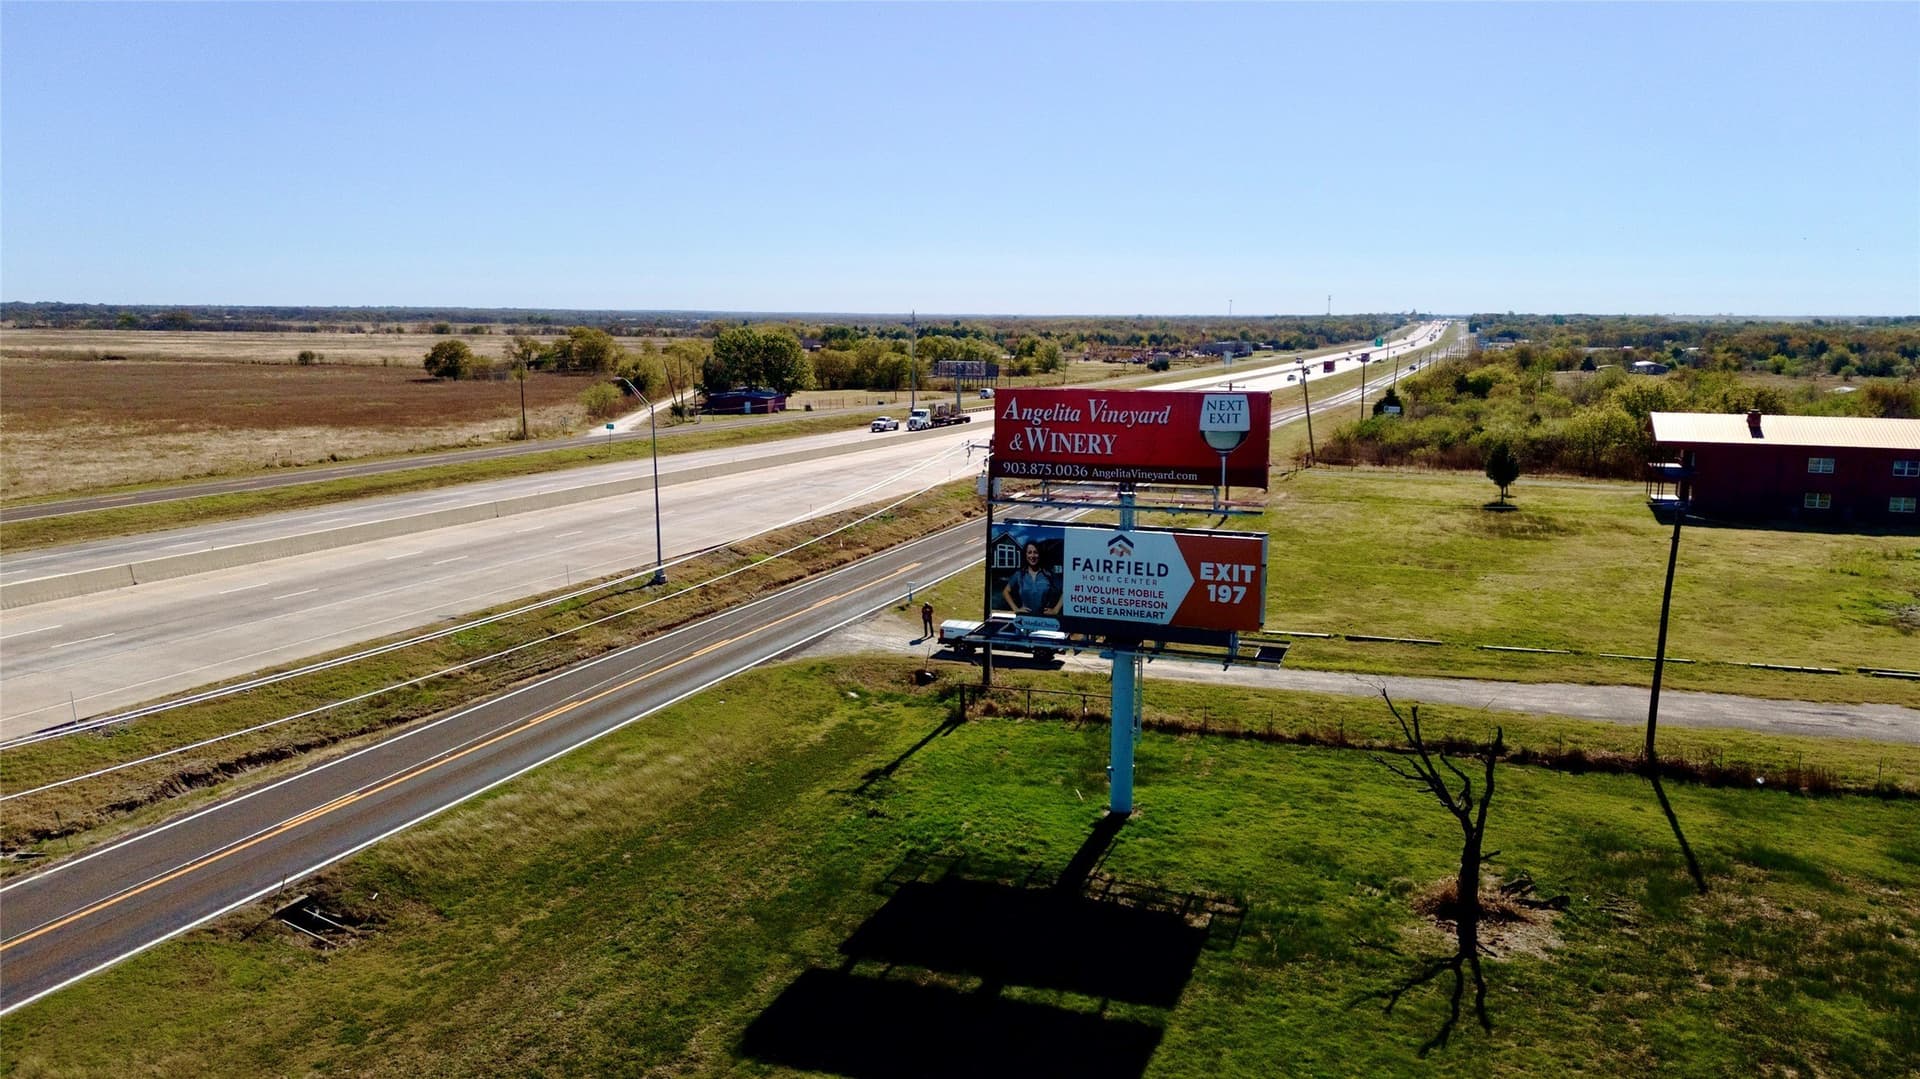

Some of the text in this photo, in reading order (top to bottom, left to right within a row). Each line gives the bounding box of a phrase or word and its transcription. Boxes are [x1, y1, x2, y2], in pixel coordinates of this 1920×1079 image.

[1001, 396, 1171, 428] Angelita Vineyard
[1206, 400, 1245, 411] NEXT
[1209, 413, 1240, 424] EXIT
[1003, 462, 1198, 481] 903.875.0036 AngelitaVineyard.com
[1072, 557, 1169, 577] FAIRFIELD
[1200, 562, 1256, 583] EXIT
[1082, 574, 1158, 586] HOME CENTER
[1087, 585, 1125, 596] VOLUME
[1128, 588, 1165, 599] MOBILE
[1207, 584, 1247, 604] 197
[1070, 594, 1168, 610] HOME SALESPERSON
[1073, 605, 1166, 620] CHLOE EARNHEART
